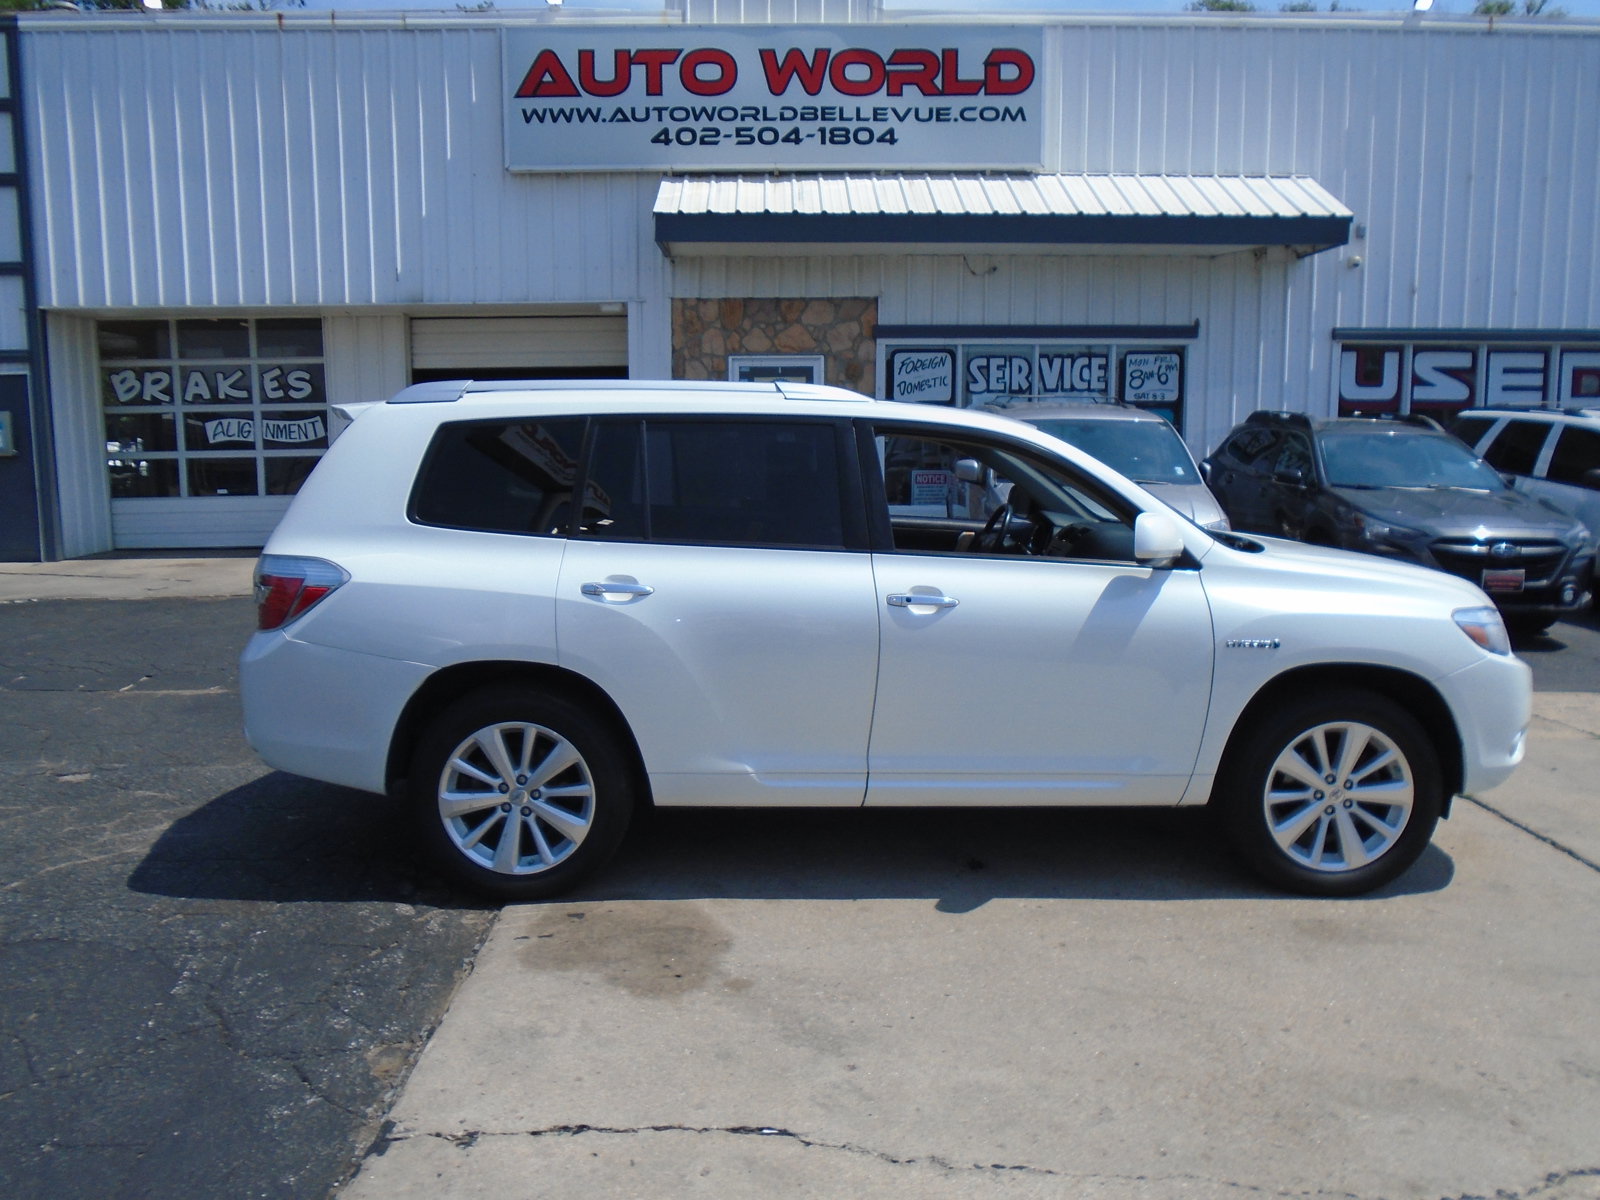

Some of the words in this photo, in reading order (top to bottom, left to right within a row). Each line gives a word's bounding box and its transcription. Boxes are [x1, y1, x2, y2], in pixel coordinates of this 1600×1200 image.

[514, 47, 738, 98] AUTO
[758, 47, 1036, 97] WORLD
[521, 105, 1027, 124] WWW.AUTOWORLDBELLEVUE.COM
[650, 126, 899, 146] 402-504-1804
[897, 355, 948, 375] FOREIGN
[967, 355, 1108, 394] SERVICE
[110, 367, 313, 403] BRAKES
[896, 376, 949, 396] DOMESTIC
[212, 418, 321, 441] ALIGNMENT
[916, 474, 946, 484] NOTICE
